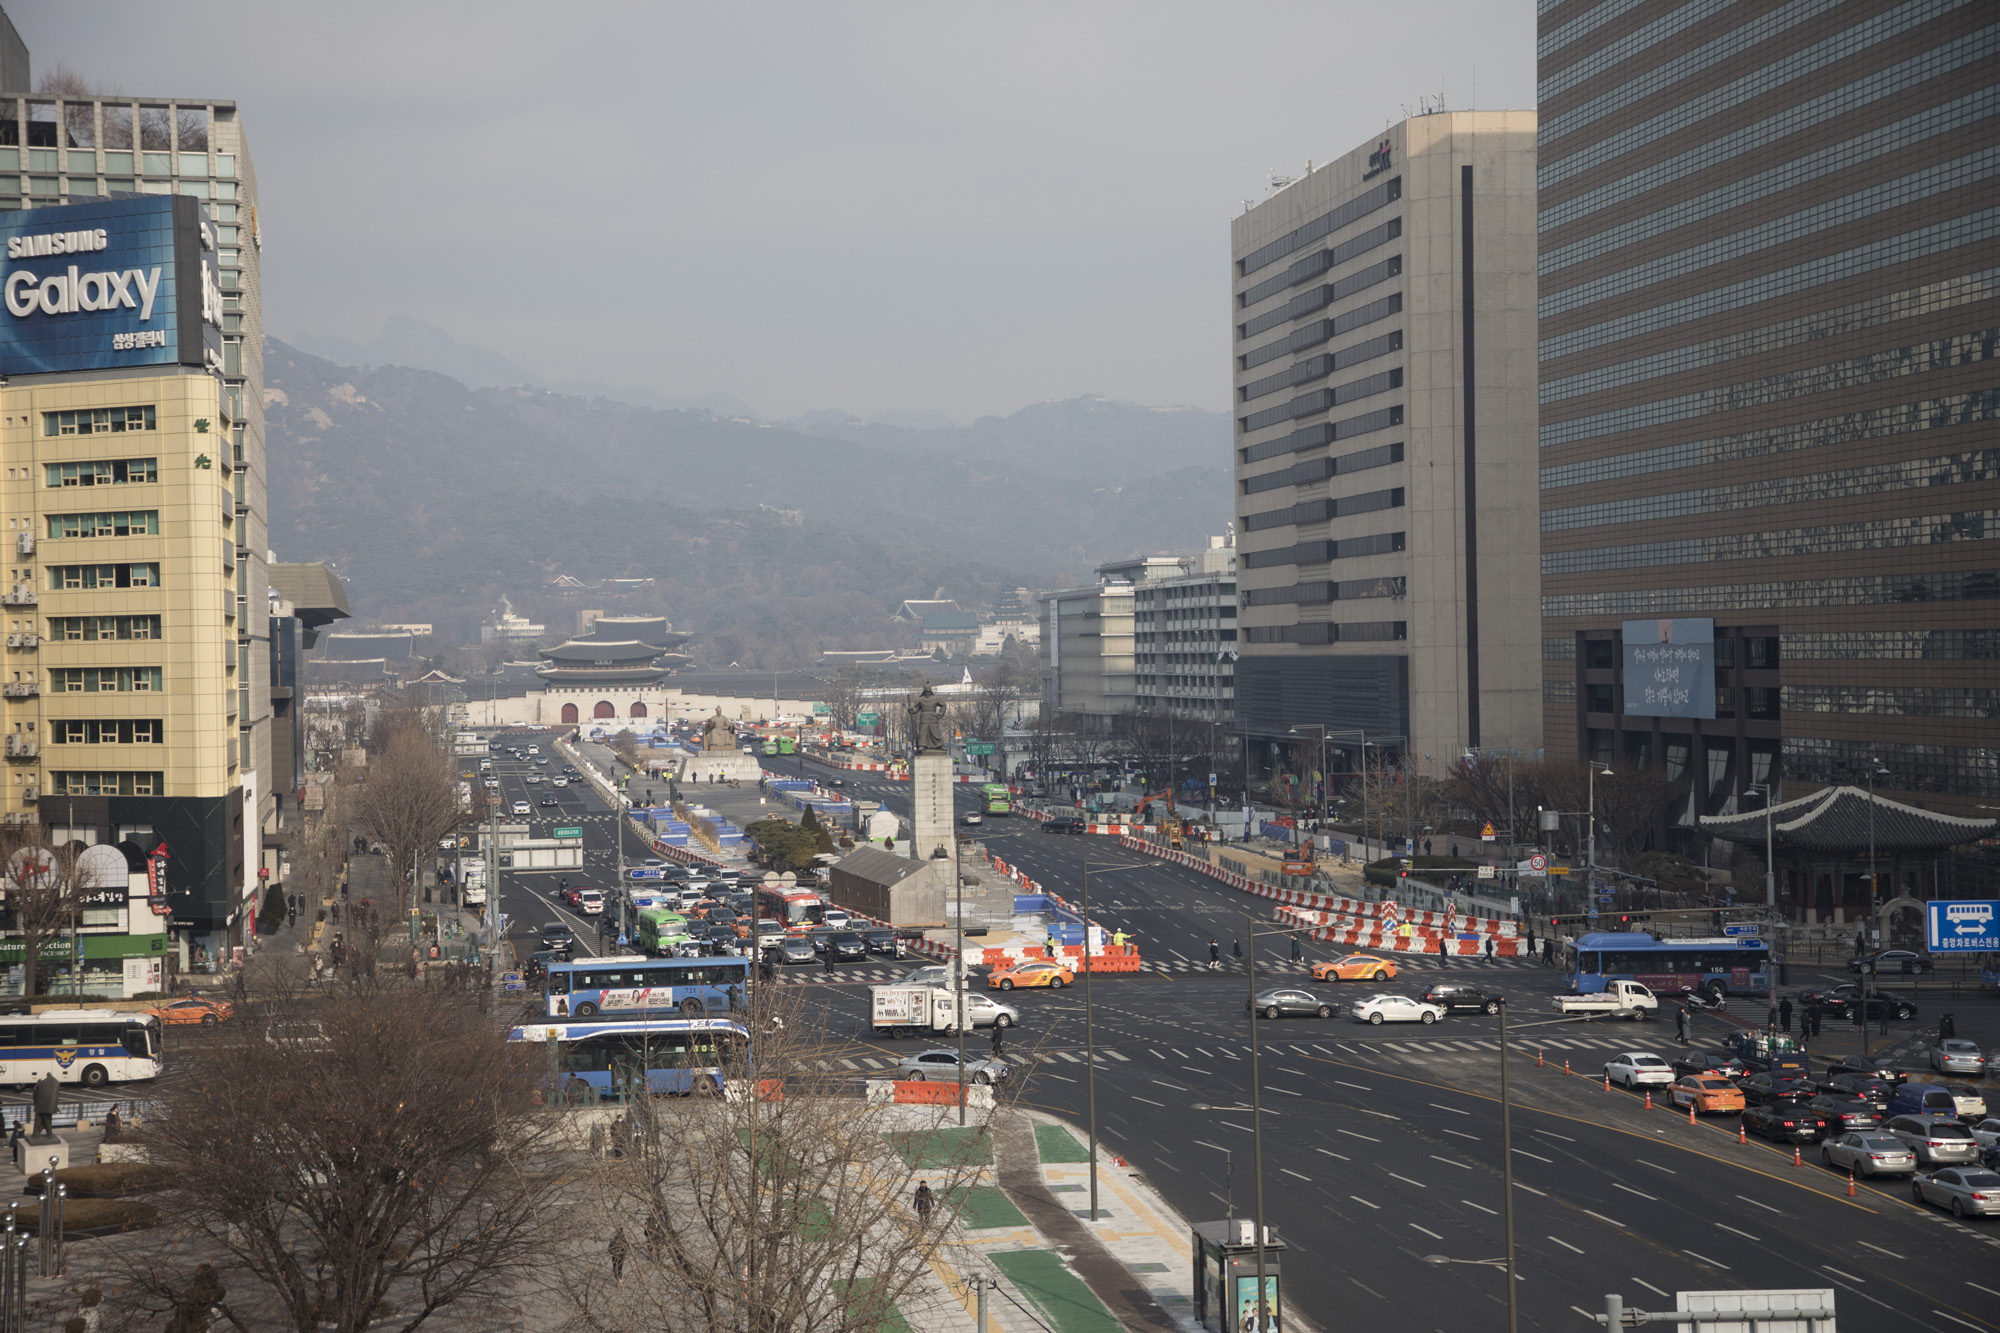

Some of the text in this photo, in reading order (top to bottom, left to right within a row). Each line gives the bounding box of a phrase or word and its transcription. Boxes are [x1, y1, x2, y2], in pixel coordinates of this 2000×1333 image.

[7, 228, 107, 259] SAMSUNG
[4, 265, 162, 321] Galaxy
[112, 330, 166, 351] 삼성갤럭시
[1653, 666, 1679, 683] 사노라면
[1644, 685, 1690, 706] 많은 기쁨이 있다고
[1533, 859, 1543, 867] 50
[1942, 937, 2000, 948] 중앙차로버스전용
[89, 1048, 105, 1056] 경찰
